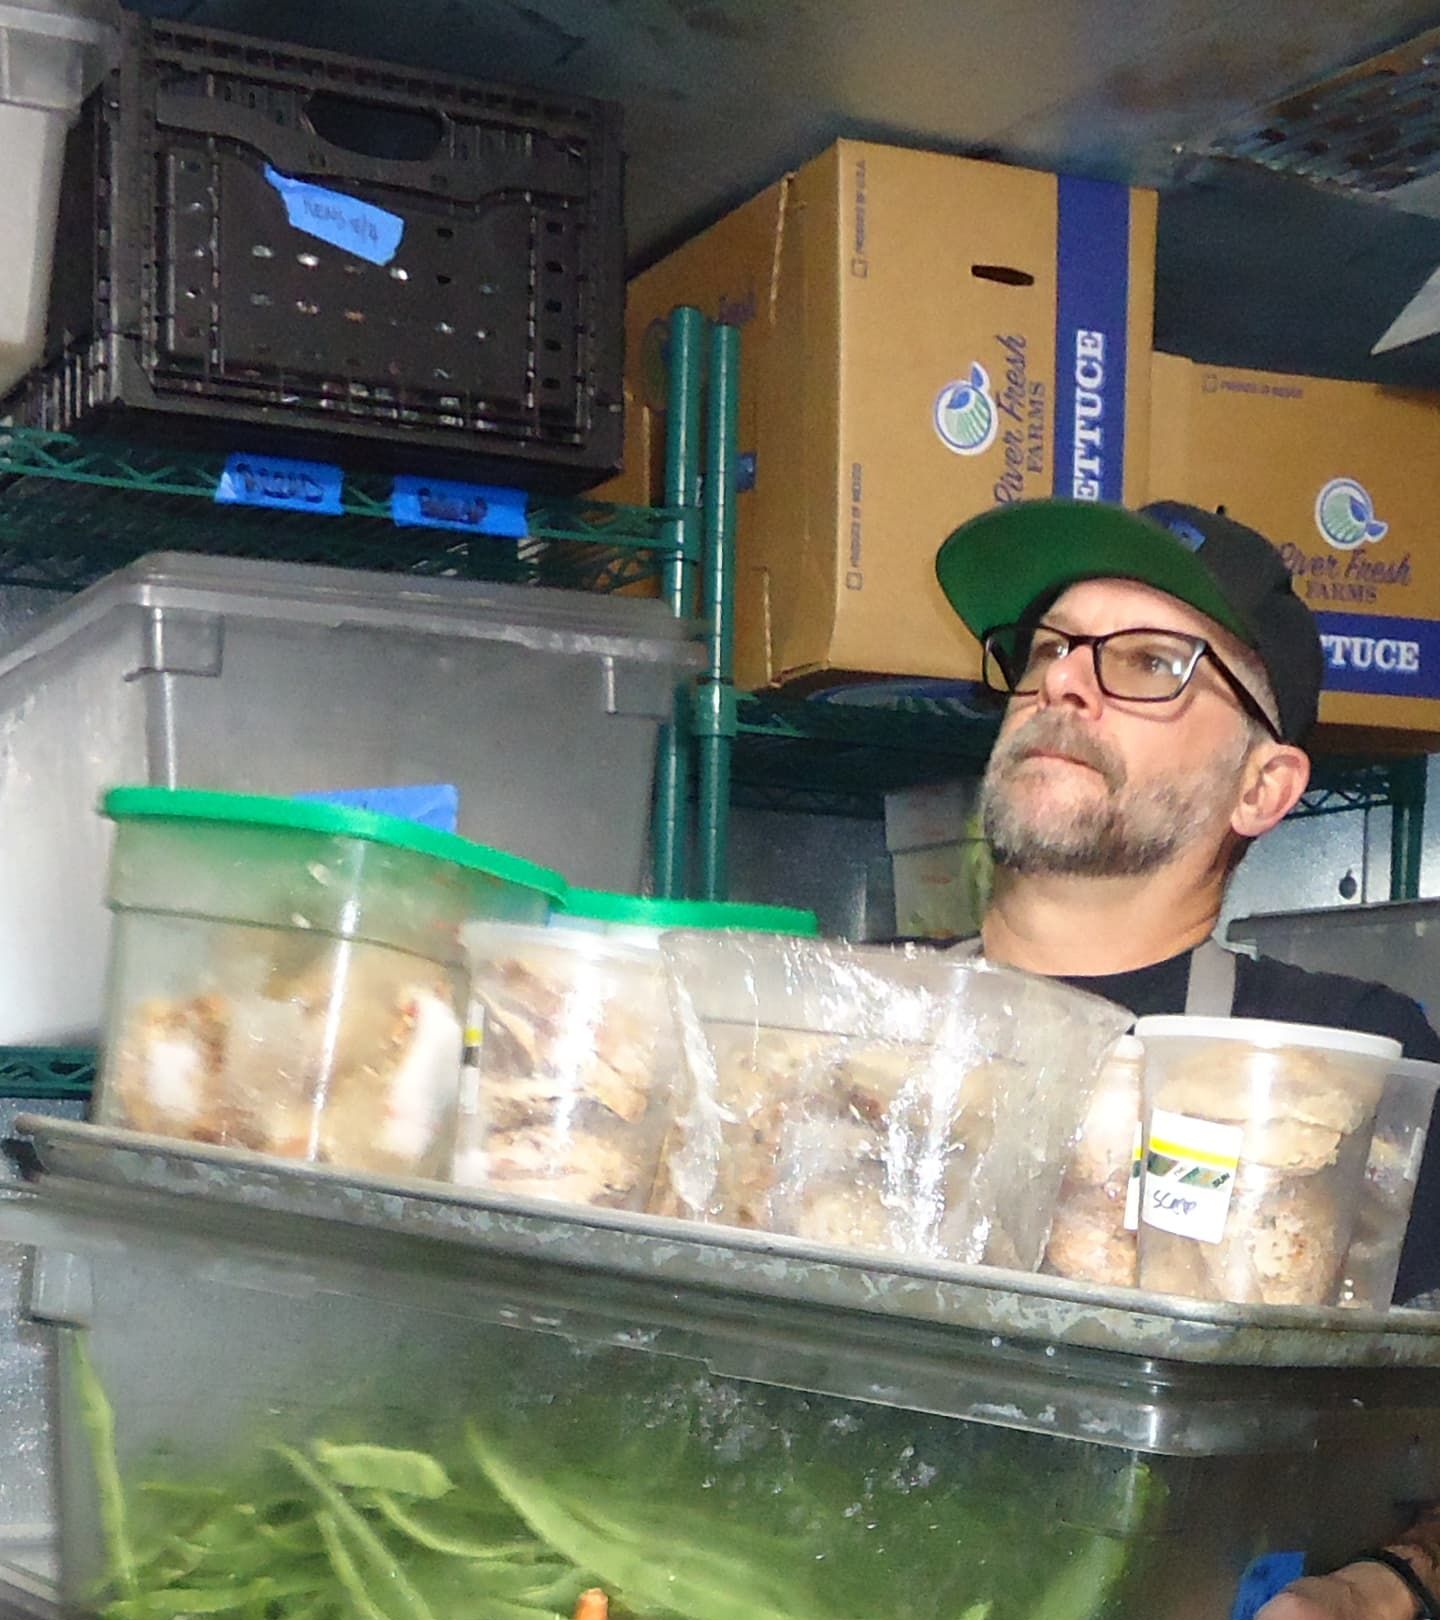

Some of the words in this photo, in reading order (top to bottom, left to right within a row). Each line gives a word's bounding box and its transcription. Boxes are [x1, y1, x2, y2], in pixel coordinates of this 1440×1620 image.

[994, 333, 1027, 422] Fresh
[1027, 381, 1046, 473] FARMS
[1073, 328, 1105, 501] ETTUCE
[993, 432, 1025, 502] River
[1279, 542, 1339, 576] River
[1344, 549, 1411, 586] Fresh
[1306, 580, 1377, 603] FARMS
[1319, 634, 1420, 672] TUCE
